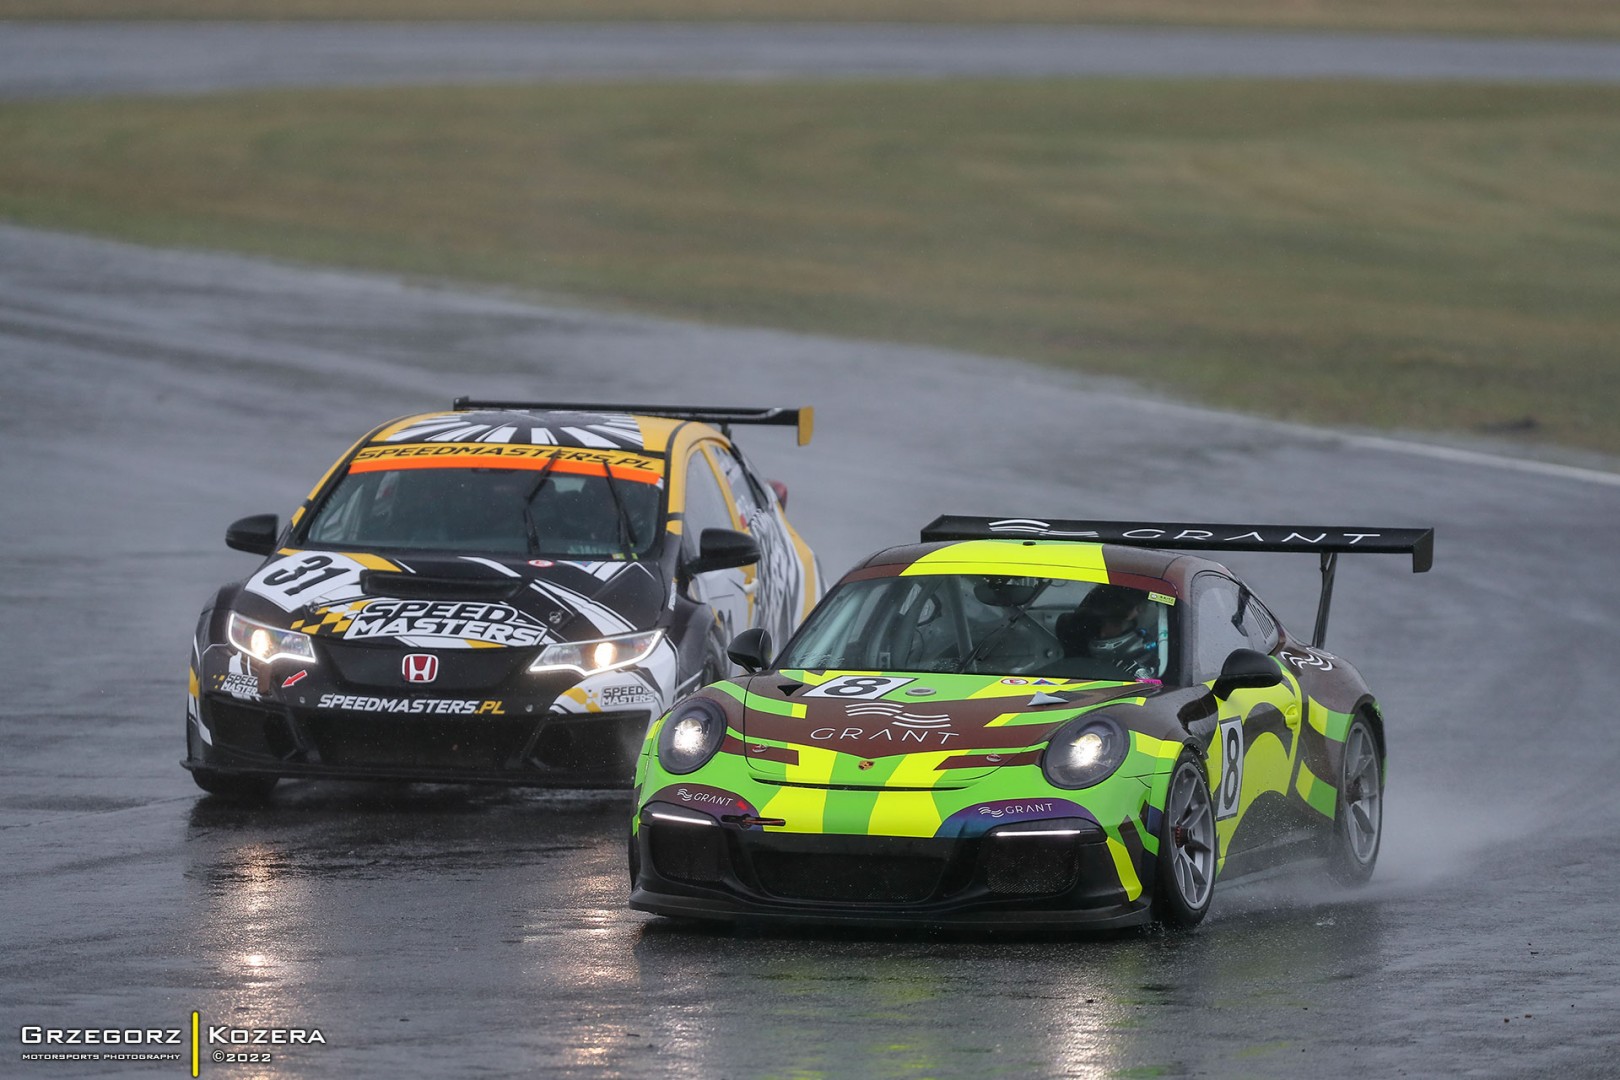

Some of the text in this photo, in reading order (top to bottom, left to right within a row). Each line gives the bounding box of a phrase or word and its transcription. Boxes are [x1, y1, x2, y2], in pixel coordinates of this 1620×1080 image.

[355, 446, 655, 471] SPEEDMASTERS.PL
[1122, 528, 1381, 545] GRANT
[262, 555, 352, 597] 31
[363, 600, 518, 624] SPEED
[343, 613, 542, 646] MASTERS
[603, 685, 645, 697] SPEED
[823, 677, 892, 697] 8
[317, 693, 506, 715] SPEEDMASTERS.PL
[602, 693, 655, 707] MASTERS
[810, 727, 960, 745] GRANT
[1223, 727, 1240, 811] 8
[693, 792, 734, 806] GRANT
[1005, 802, 1053, 815] GRANT
